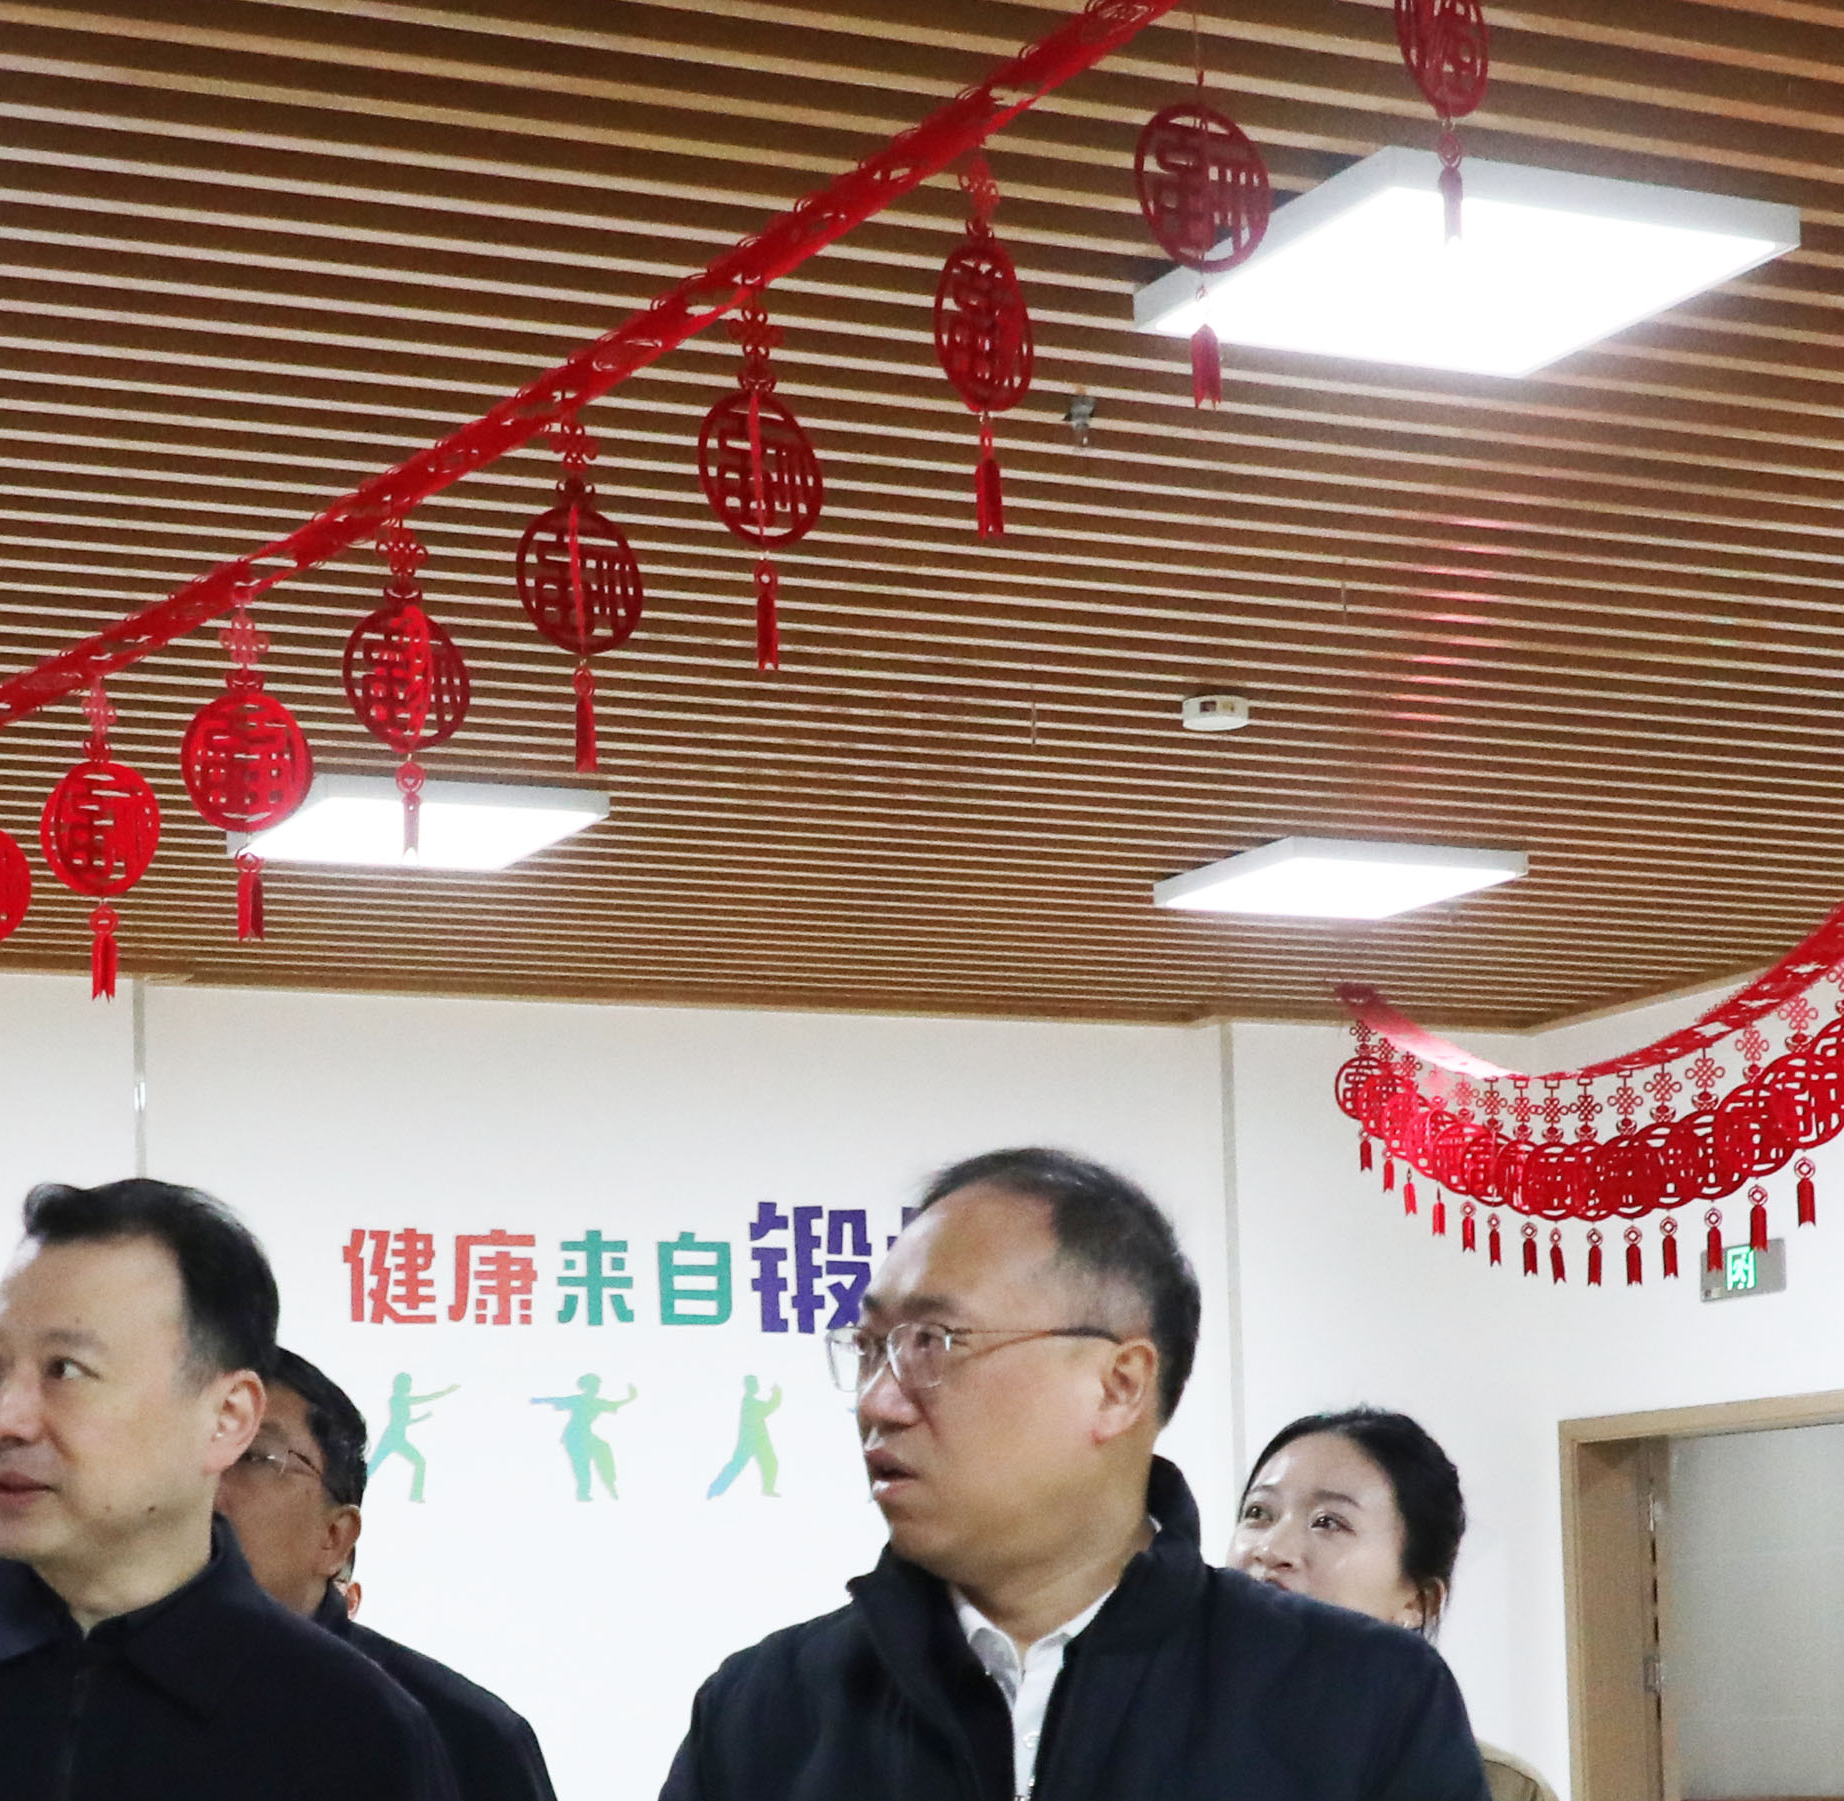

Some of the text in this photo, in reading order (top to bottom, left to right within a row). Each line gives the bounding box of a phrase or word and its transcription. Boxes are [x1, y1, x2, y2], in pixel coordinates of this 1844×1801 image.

[341, 1200, 920, 1334] 健康来自锻
